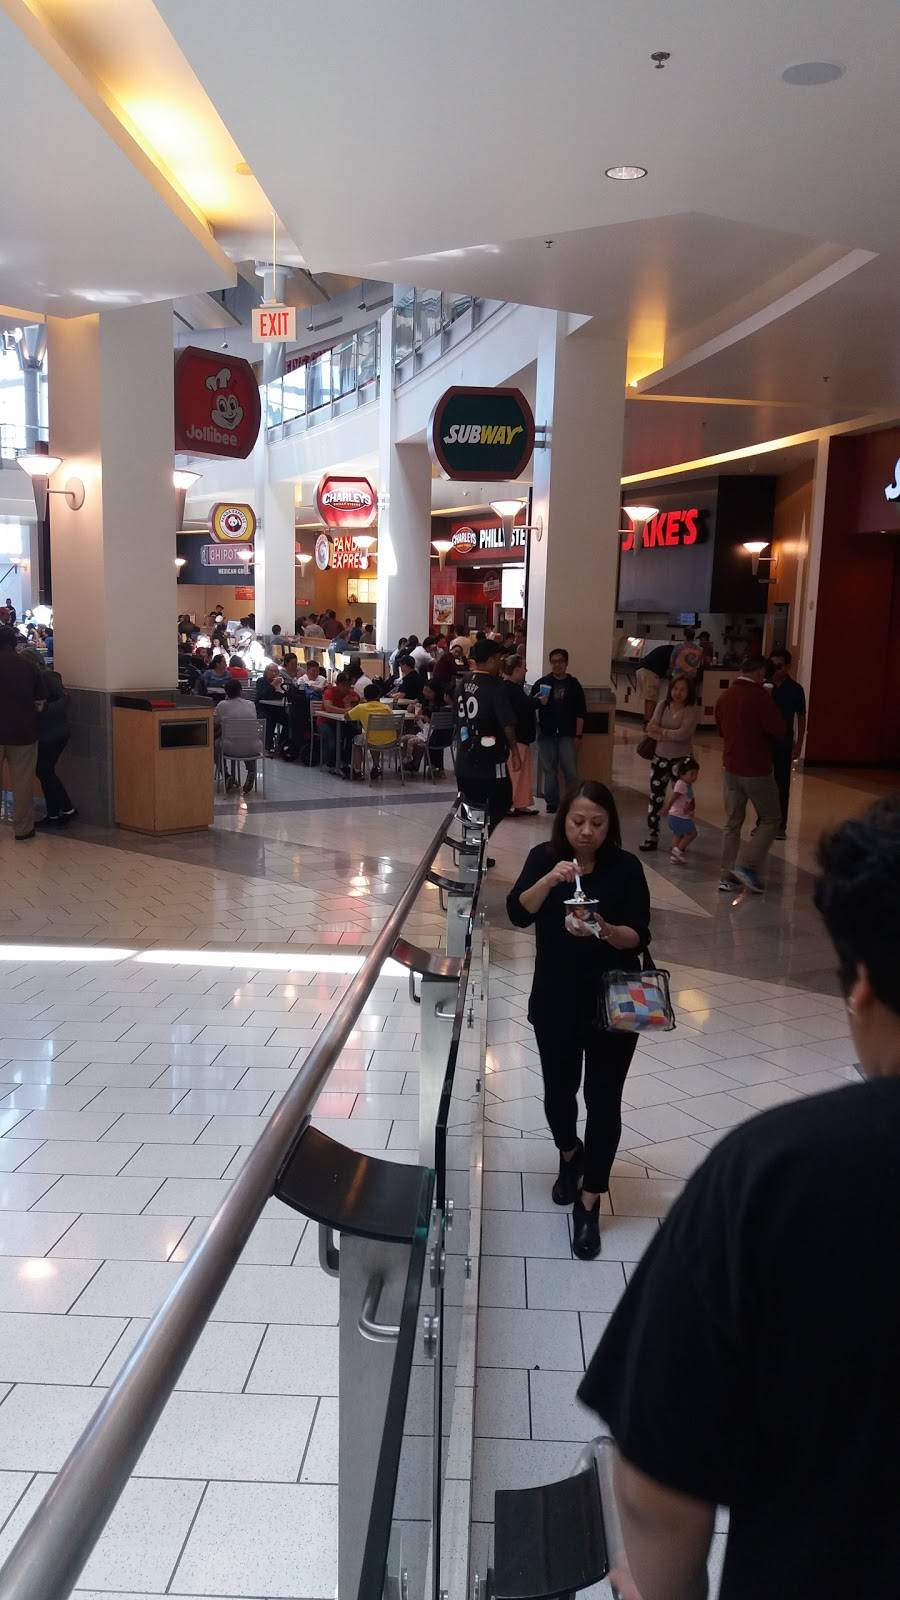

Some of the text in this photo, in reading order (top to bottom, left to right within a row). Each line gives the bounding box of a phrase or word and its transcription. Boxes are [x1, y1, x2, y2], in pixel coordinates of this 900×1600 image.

[259, 312, 290, 337] EXIT
[186, 423, 238, 447] Jollibee
[443, 424, 524, 446] SUBWAY
[322, 492, 372, 506] CHARLEYS
[333, 536, 363, 552] PAND
[451, 532, 477, 545] CHARLEYS
[210, 548, 246, 561] CHIPOT
[332, 553, 369, 569] EXPRES
